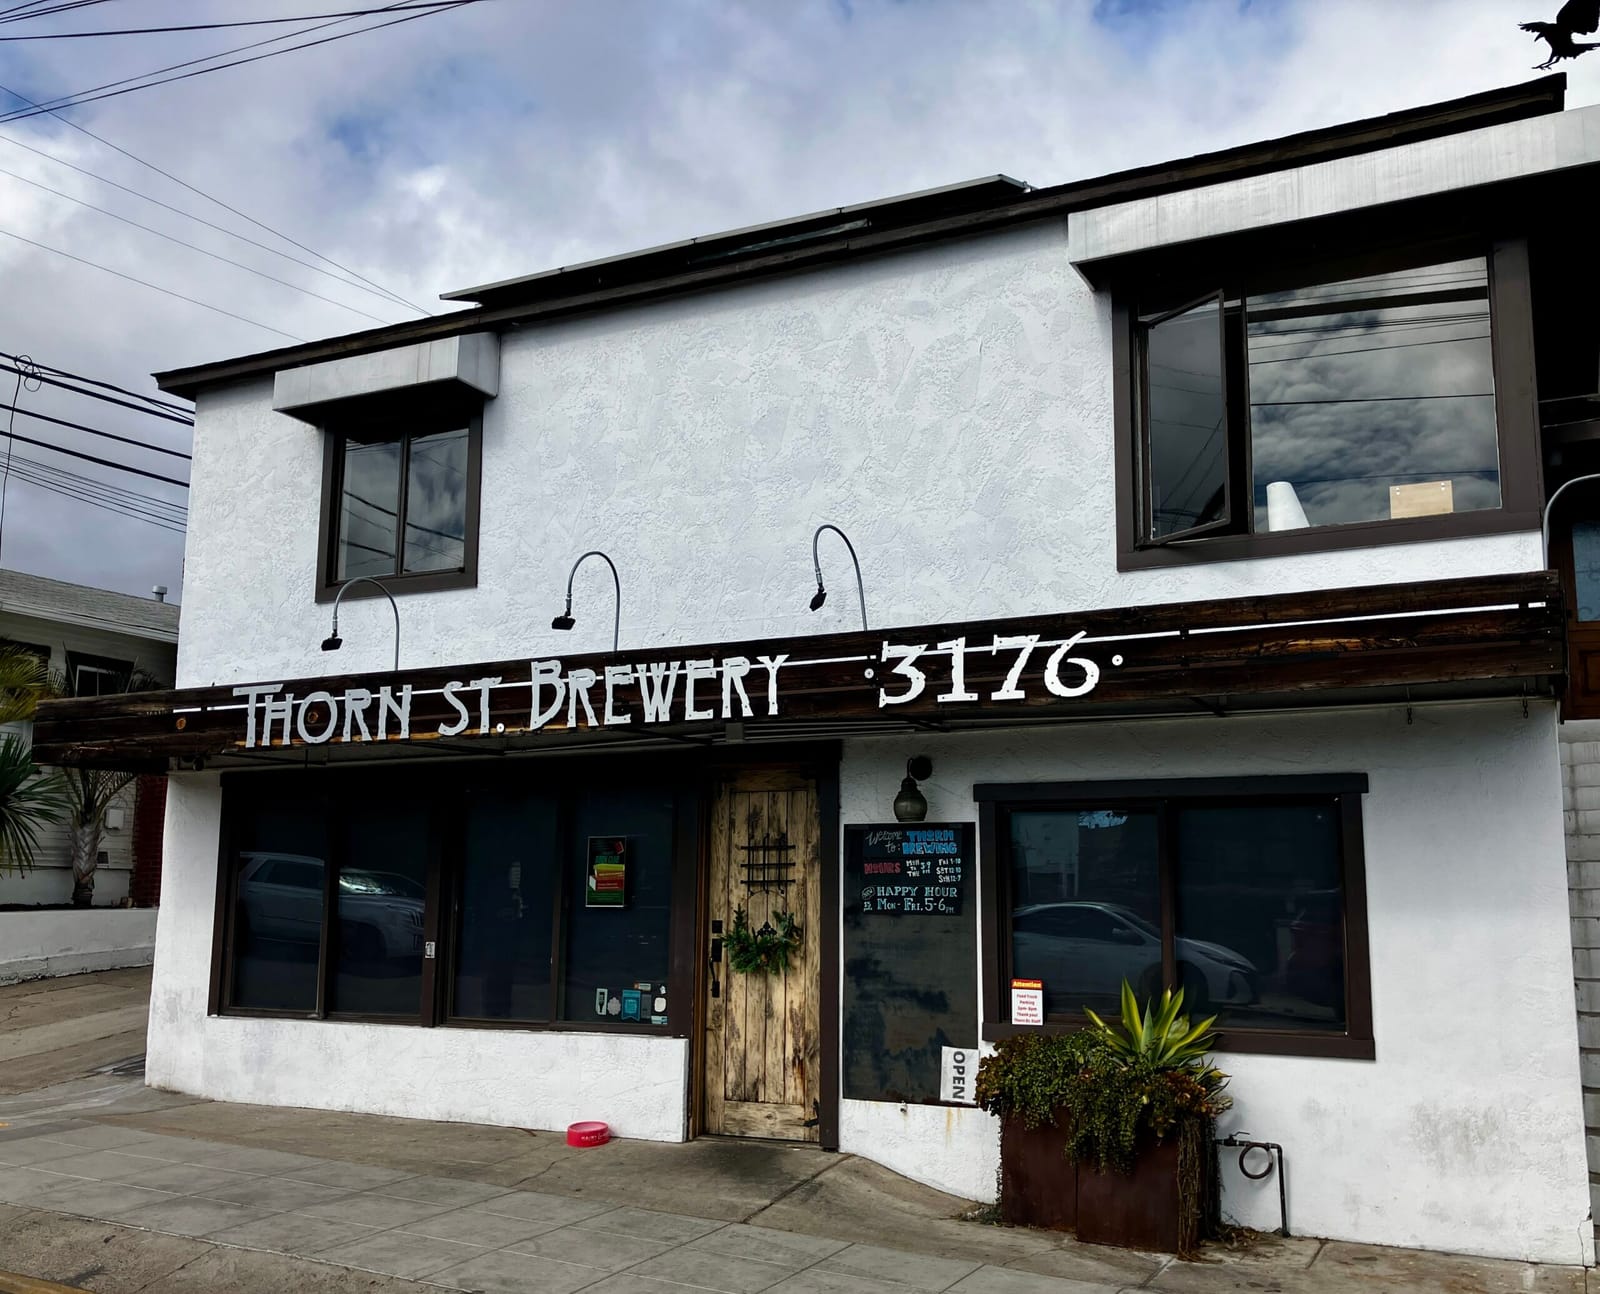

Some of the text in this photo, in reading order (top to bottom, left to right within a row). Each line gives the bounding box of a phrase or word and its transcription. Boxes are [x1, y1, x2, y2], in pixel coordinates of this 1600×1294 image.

[879, 630, 1100, 708] 3176
[233, 654, 790, 748] THORN ST. BREWERY
[902, 842, 958, 855] BREWING
[906, 829, 955, 842] THORN
[876, 886, 958, 898] HAPPY HOUR
[952, 1050, 966, 1100] OPEN
